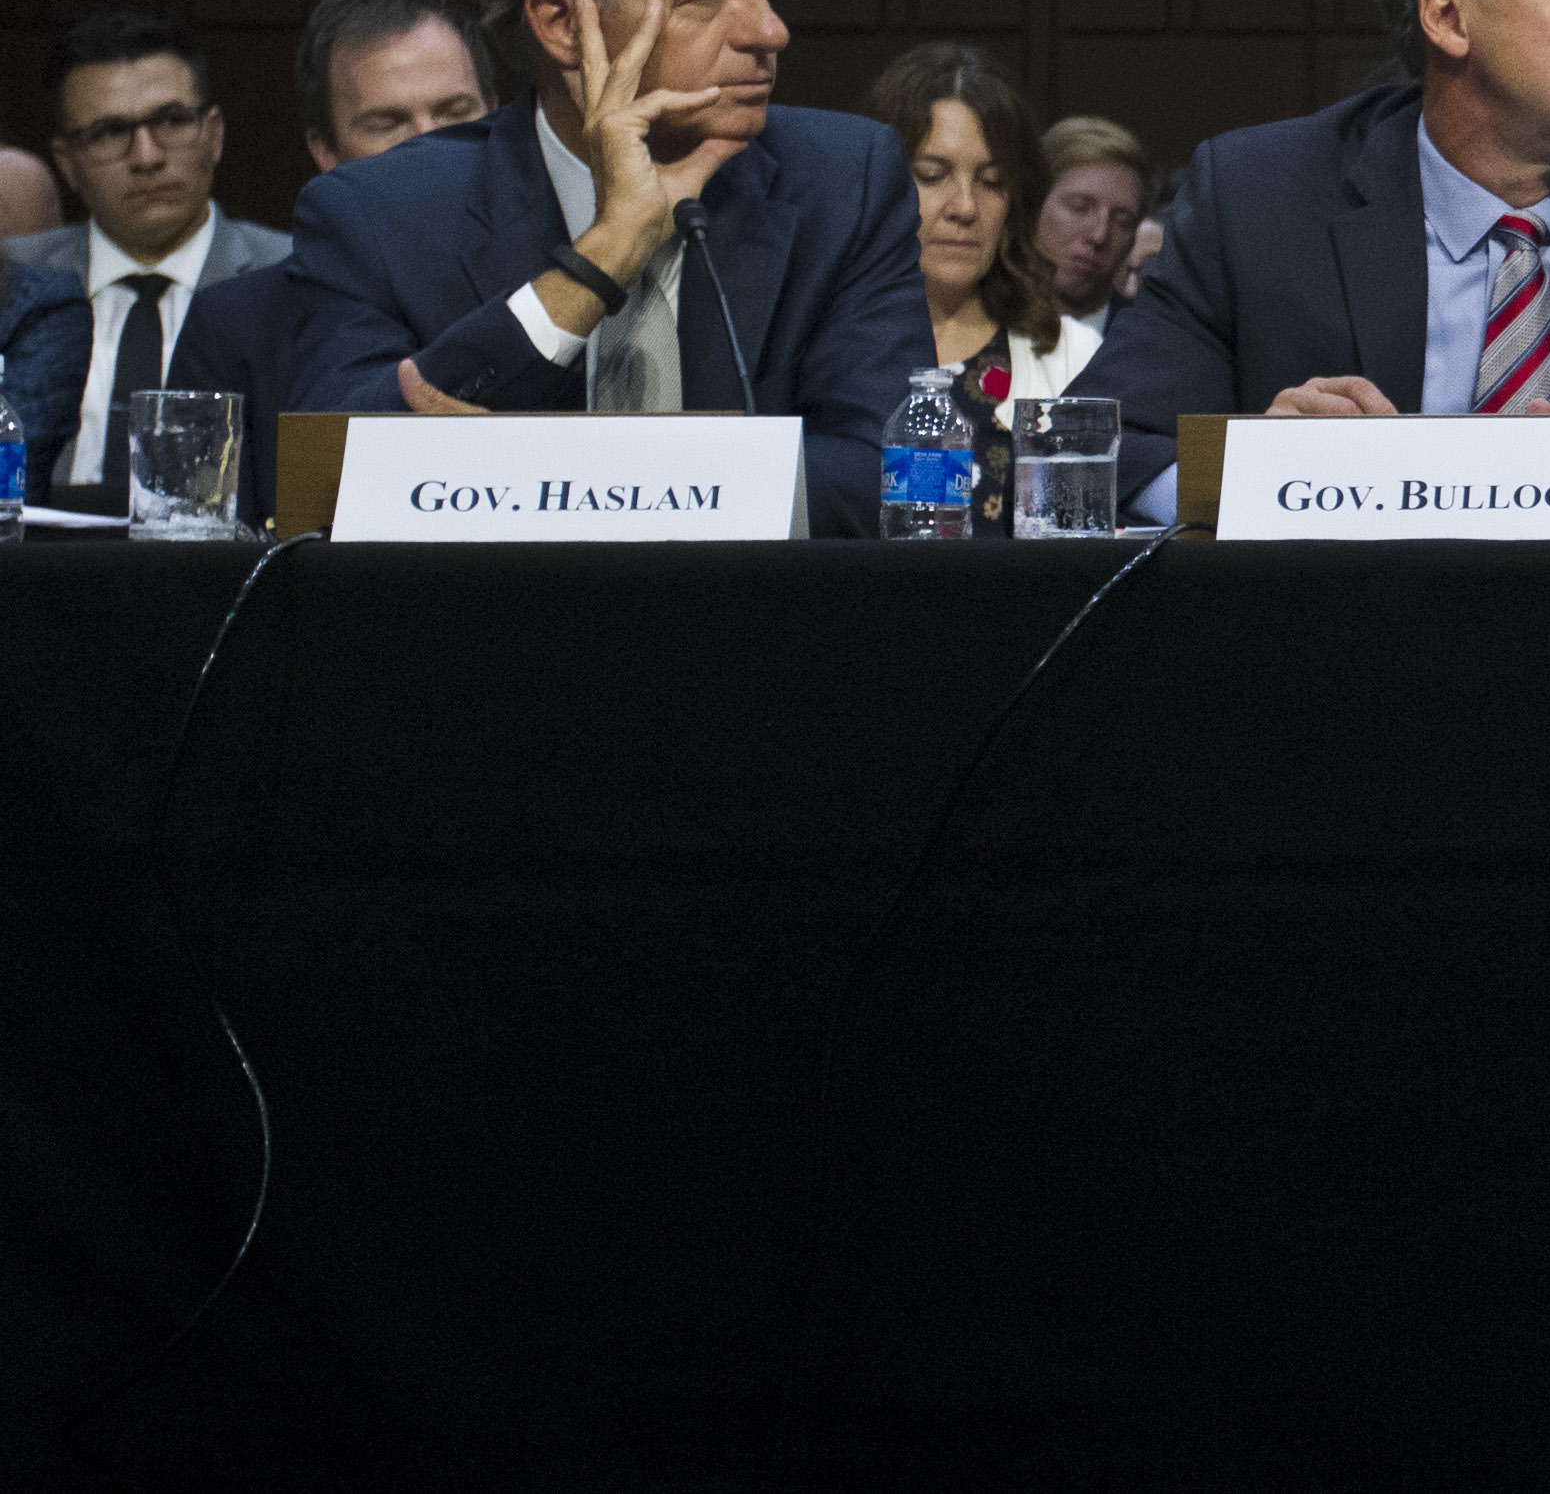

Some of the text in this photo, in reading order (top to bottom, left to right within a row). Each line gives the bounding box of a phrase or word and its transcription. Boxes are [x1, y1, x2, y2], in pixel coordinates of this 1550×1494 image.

[410, 481, 721, 511] GOV. HASLAM
[1277, 480, 1384, 511] GOV.
